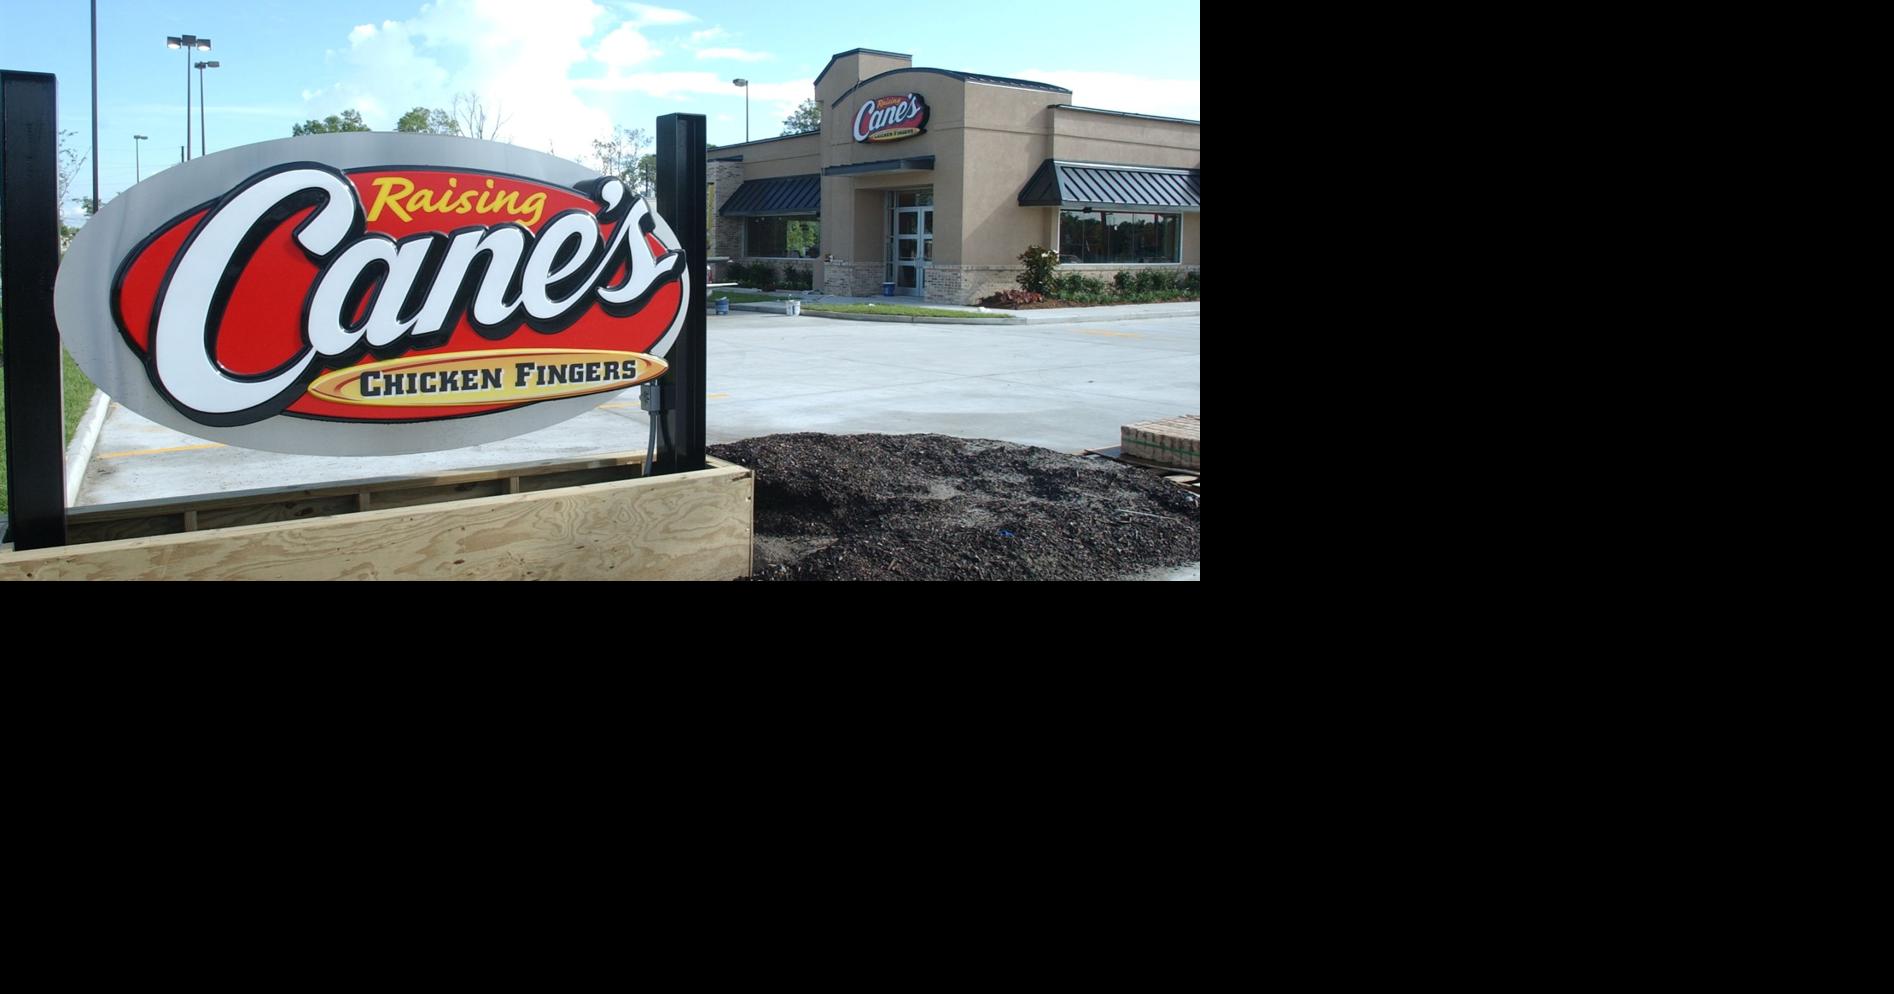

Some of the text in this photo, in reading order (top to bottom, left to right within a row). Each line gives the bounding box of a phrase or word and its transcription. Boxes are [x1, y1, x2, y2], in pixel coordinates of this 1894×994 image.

[854, 93, 920, 141] Cane's
[367, 176, 546, 226] Raising
[155, 168, 680, 413] Cane's
[360, 358, 637, 397] CHICKEN FINGERS
